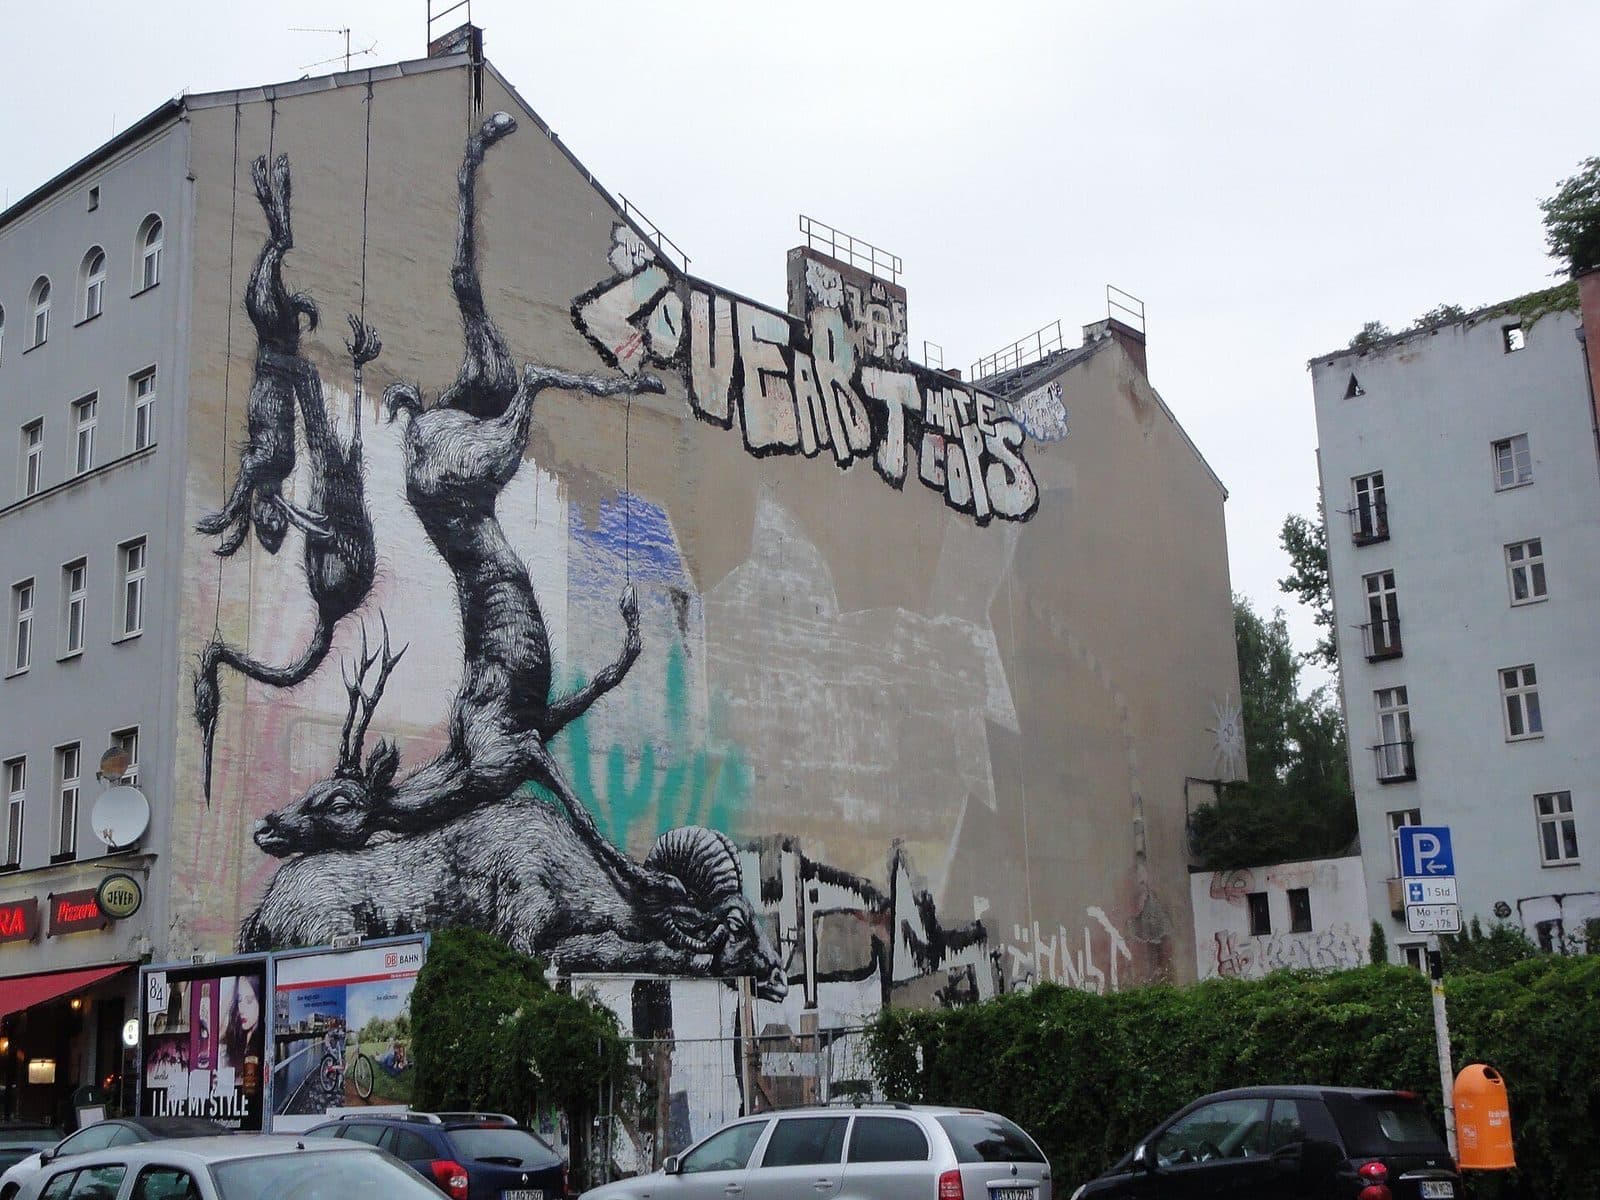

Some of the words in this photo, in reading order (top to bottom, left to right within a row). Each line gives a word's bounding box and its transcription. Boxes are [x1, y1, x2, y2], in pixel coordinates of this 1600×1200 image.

[926, 387, 996, 437] HATE
[918, 420, 1040, 528] COPS
[1412, 833, 1441, 874] P
[107, 891, 134, 906] JEVER
[1427, 888, 1432, 896] 1
[1417, 908, 1431, 917] Mo
[1440, 907, 1450, 916] Fr
[1419, 920, 1425, 928] 9
[1436, 919, 1452, 928] 17h
[386, 955, 397, 967] DB
[400, 954, 419, 964] BAHN
[209, 1088, 249, 1117] STYLE
